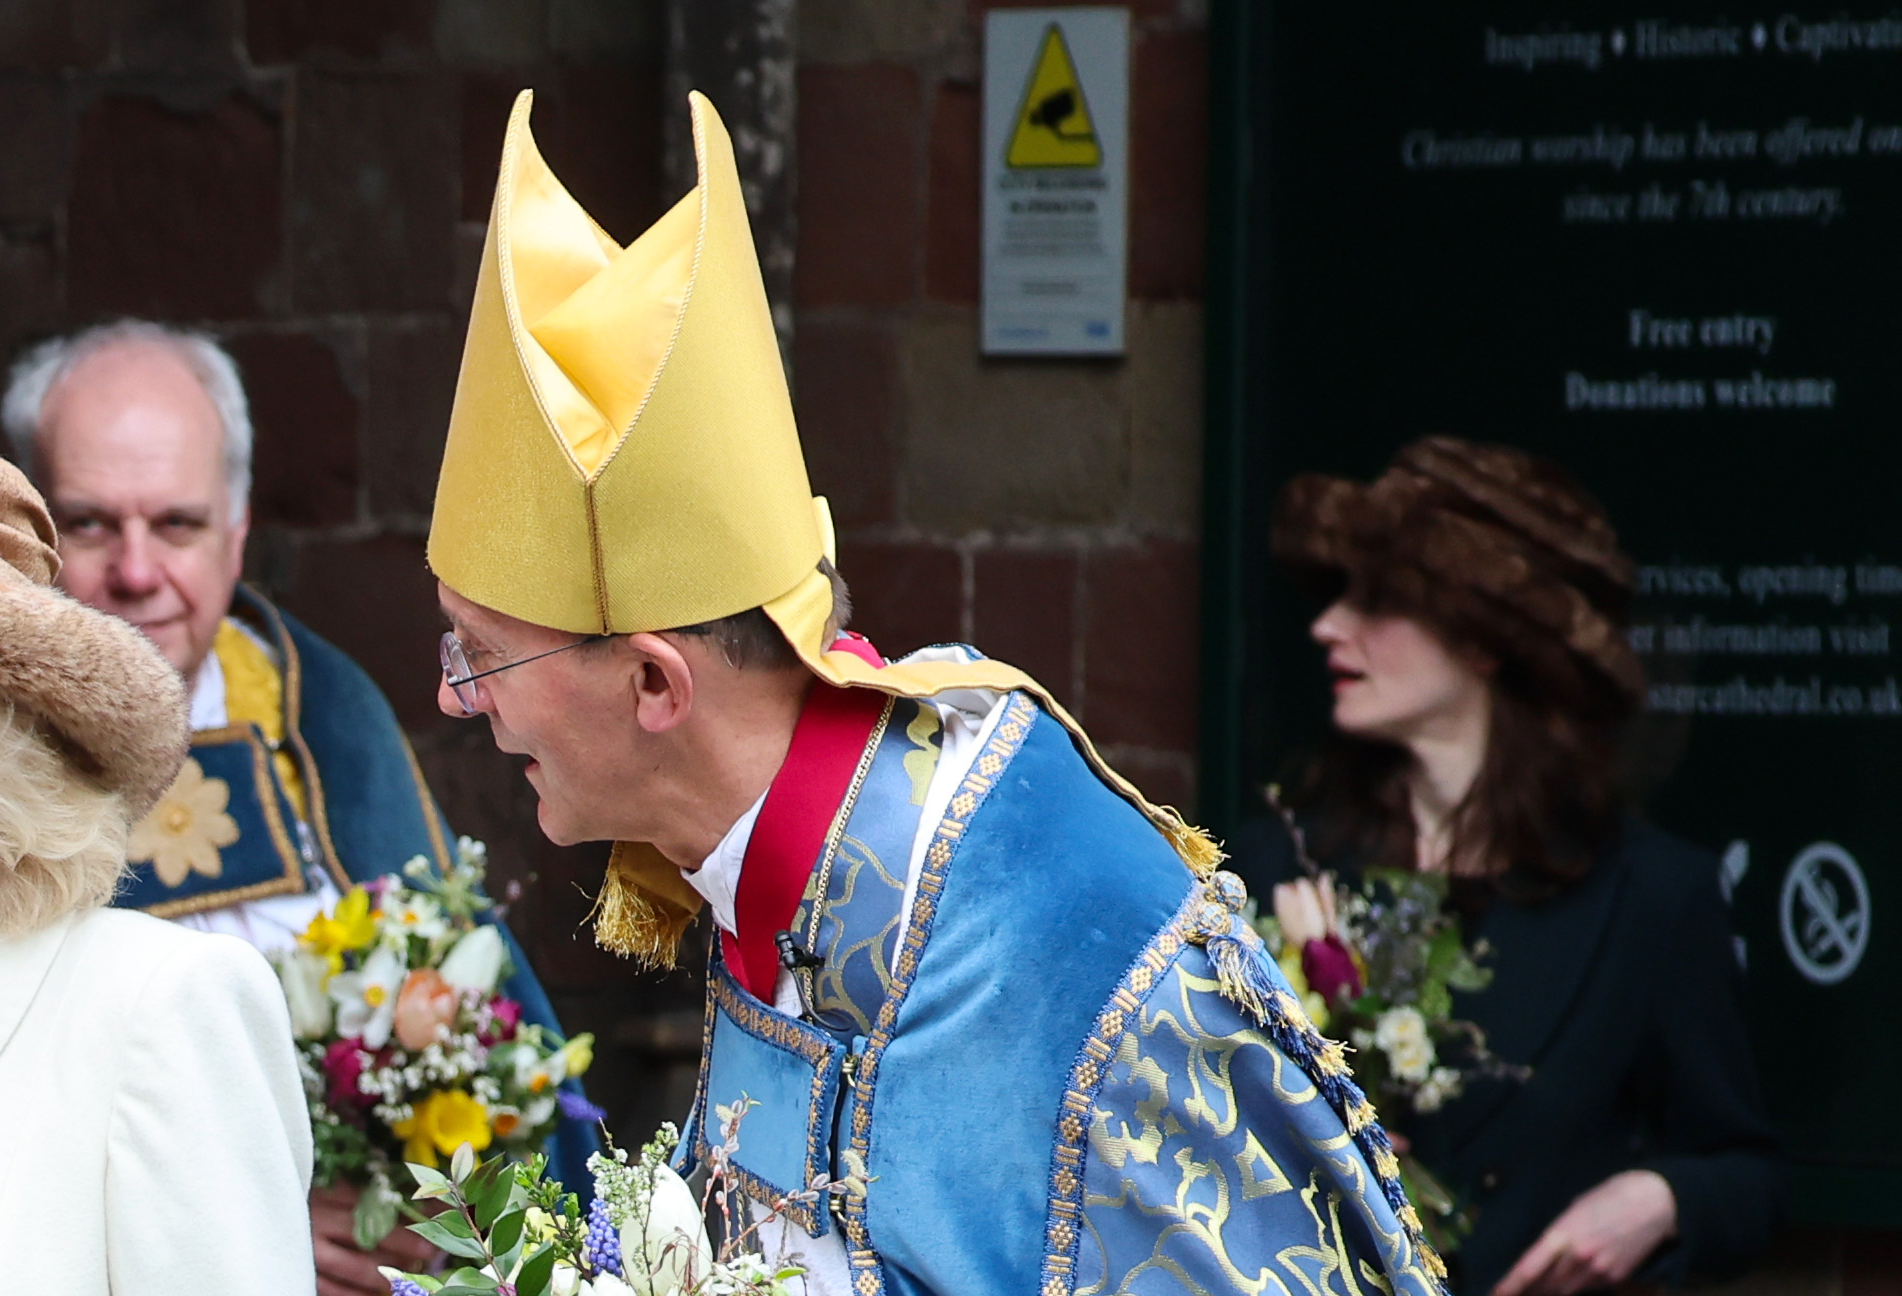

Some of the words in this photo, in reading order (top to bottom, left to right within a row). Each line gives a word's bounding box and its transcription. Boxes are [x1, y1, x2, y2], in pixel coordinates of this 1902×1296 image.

[1485, 24, 1603, 72] Inspiring
[1635, 18, 1742, 57] Historic
[1775, 13, 1902, 63] Captivati
[1402, 129, 1523, 170] Christian
[1531, 123, 1636, 173] worship
[1640, 121, 1686, 158] has
[1695, 118, 1758, 157] been
[1764, 115, 1864, 166] offered
[1564, 187, 1632, 221] since
[1637, 180, 1681, 220] the
[1689, 179, 1731, 217] 7th
[1736, 188, 1845, 225] century.
[1629, 307, 1693, 348] Free
[1699, 311, 1776, 355] entry
[1566, 370, 1707, 410] Donations
[1714, 369, 1837, 409] welcome
[1739, 557, 1847, 604] opening
[1663, 614, 1821, 653] information
[1830, 615, 1889, 654] visit
